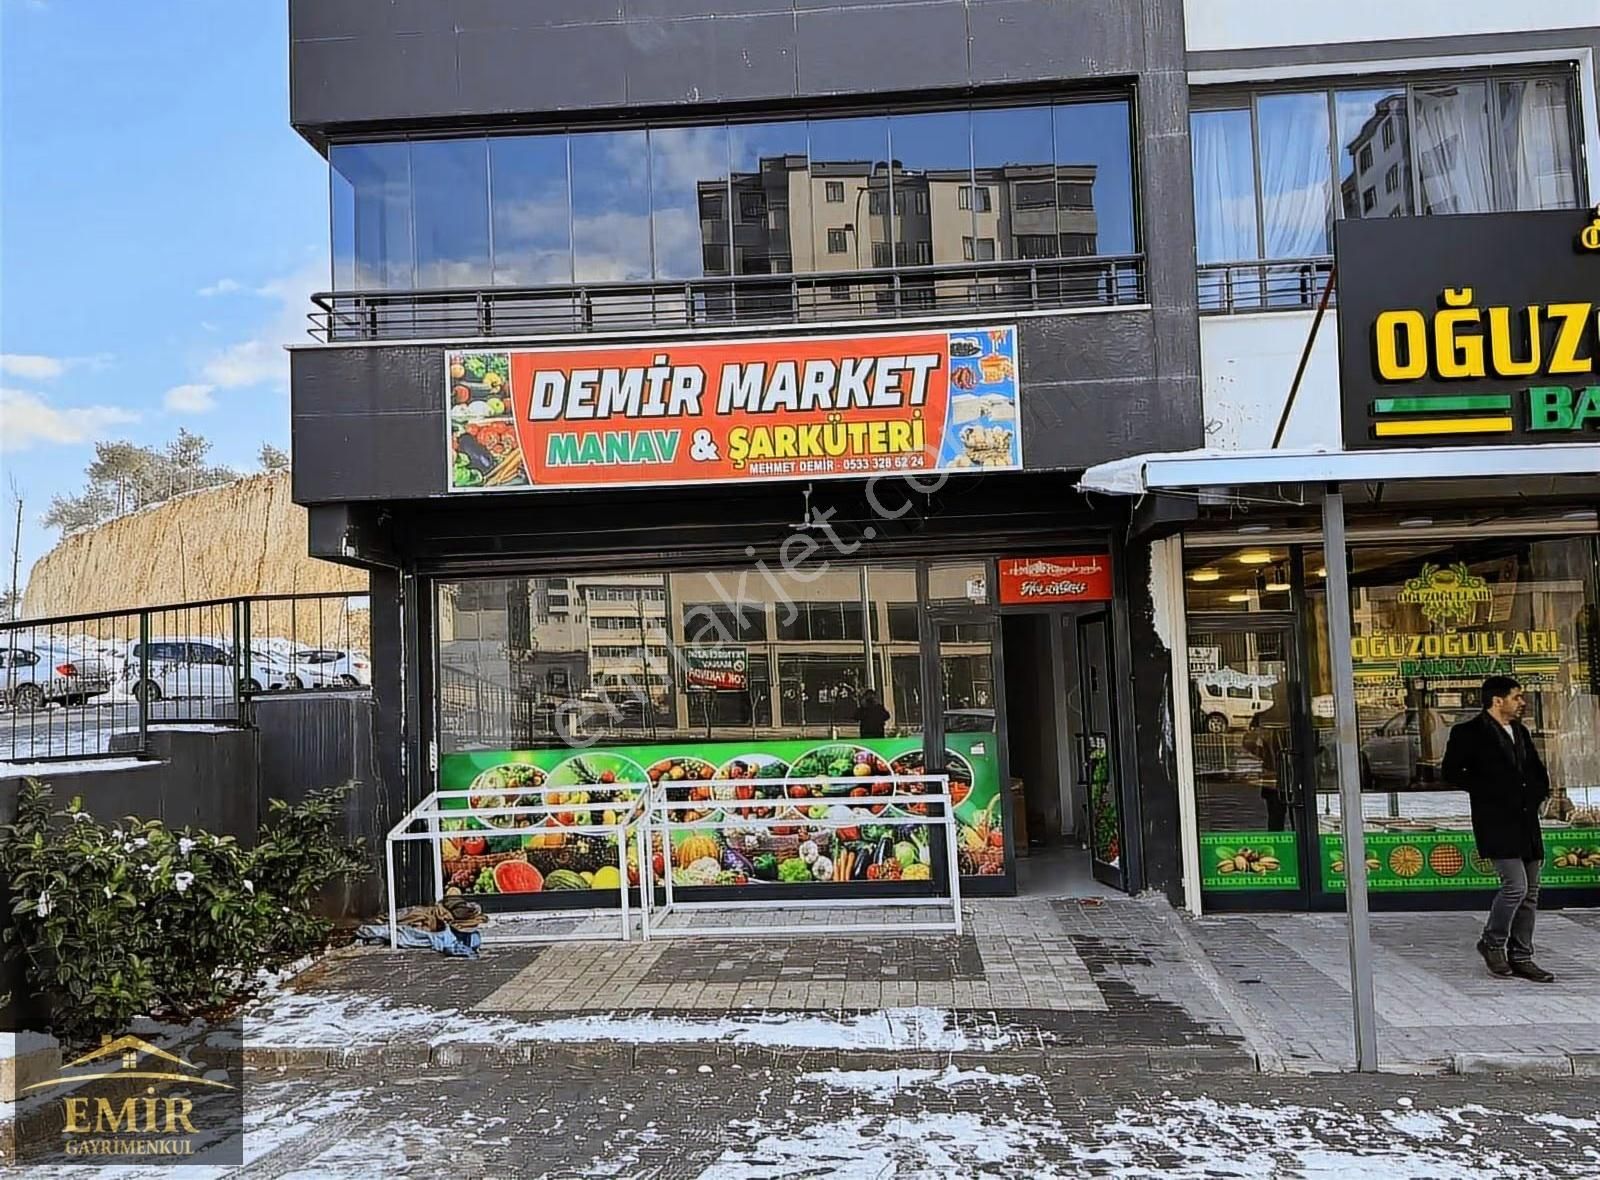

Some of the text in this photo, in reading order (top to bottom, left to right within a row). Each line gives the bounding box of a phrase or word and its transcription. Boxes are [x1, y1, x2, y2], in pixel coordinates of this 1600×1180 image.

[1376, 287, 1600, 380] OĞUZ
[528, 353, 941, 421] DEMİR MARKET
[545, 409, 924, 469] MANAV & ŞARKÜTERİ
[749, 461, 797, 475] MEHMET
[800, 459, 834, 473] DEMİR
[843, 458, 869, 470] 0533
[911, 455, 924, 467] 24
[1351, 628, 1560, 658] OĞUZOĞULLARI
